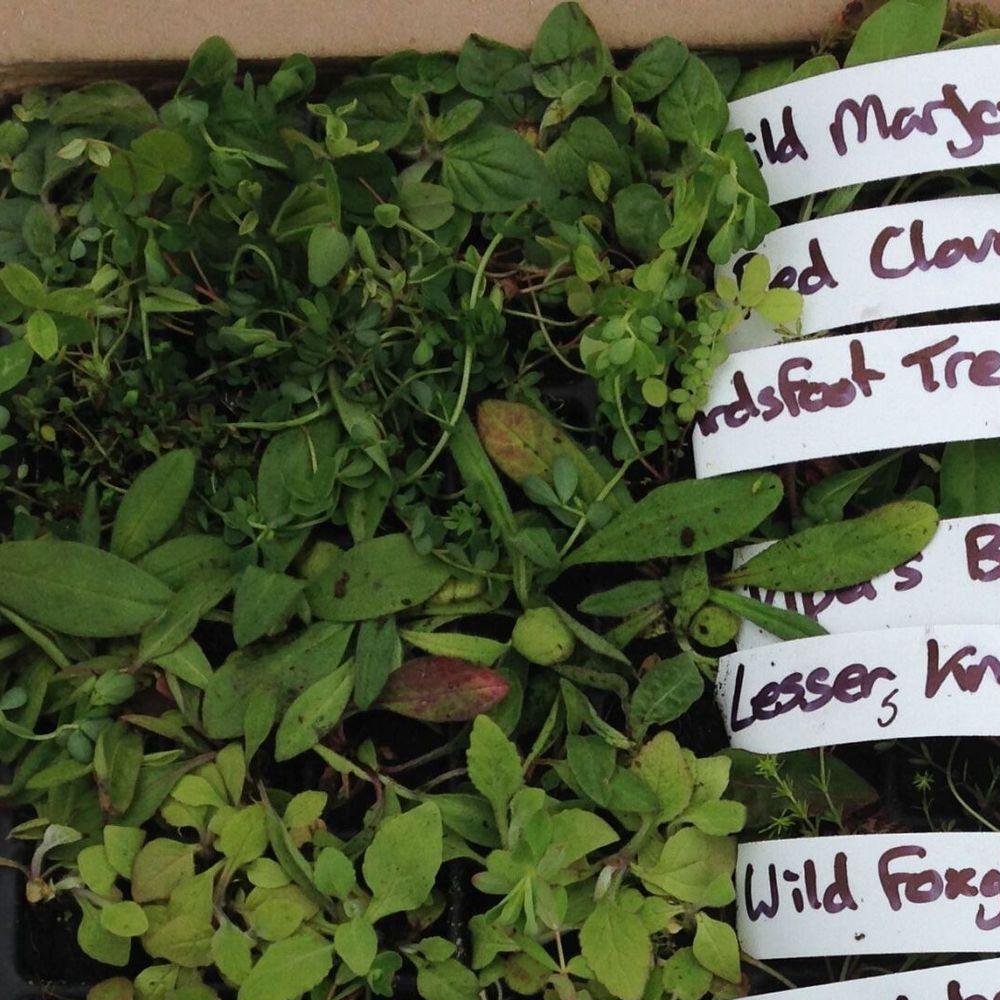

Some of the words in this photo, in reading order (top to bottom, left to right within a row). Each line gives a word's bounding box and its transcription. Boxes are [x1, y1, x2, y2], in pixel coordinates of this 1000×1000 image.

[744, 105, 809, 165] ild
[695, 339, 885, 436] rdsfoot
[731, 664, 897, 731] Lesser
[745, 852, 858, 921] Wild
